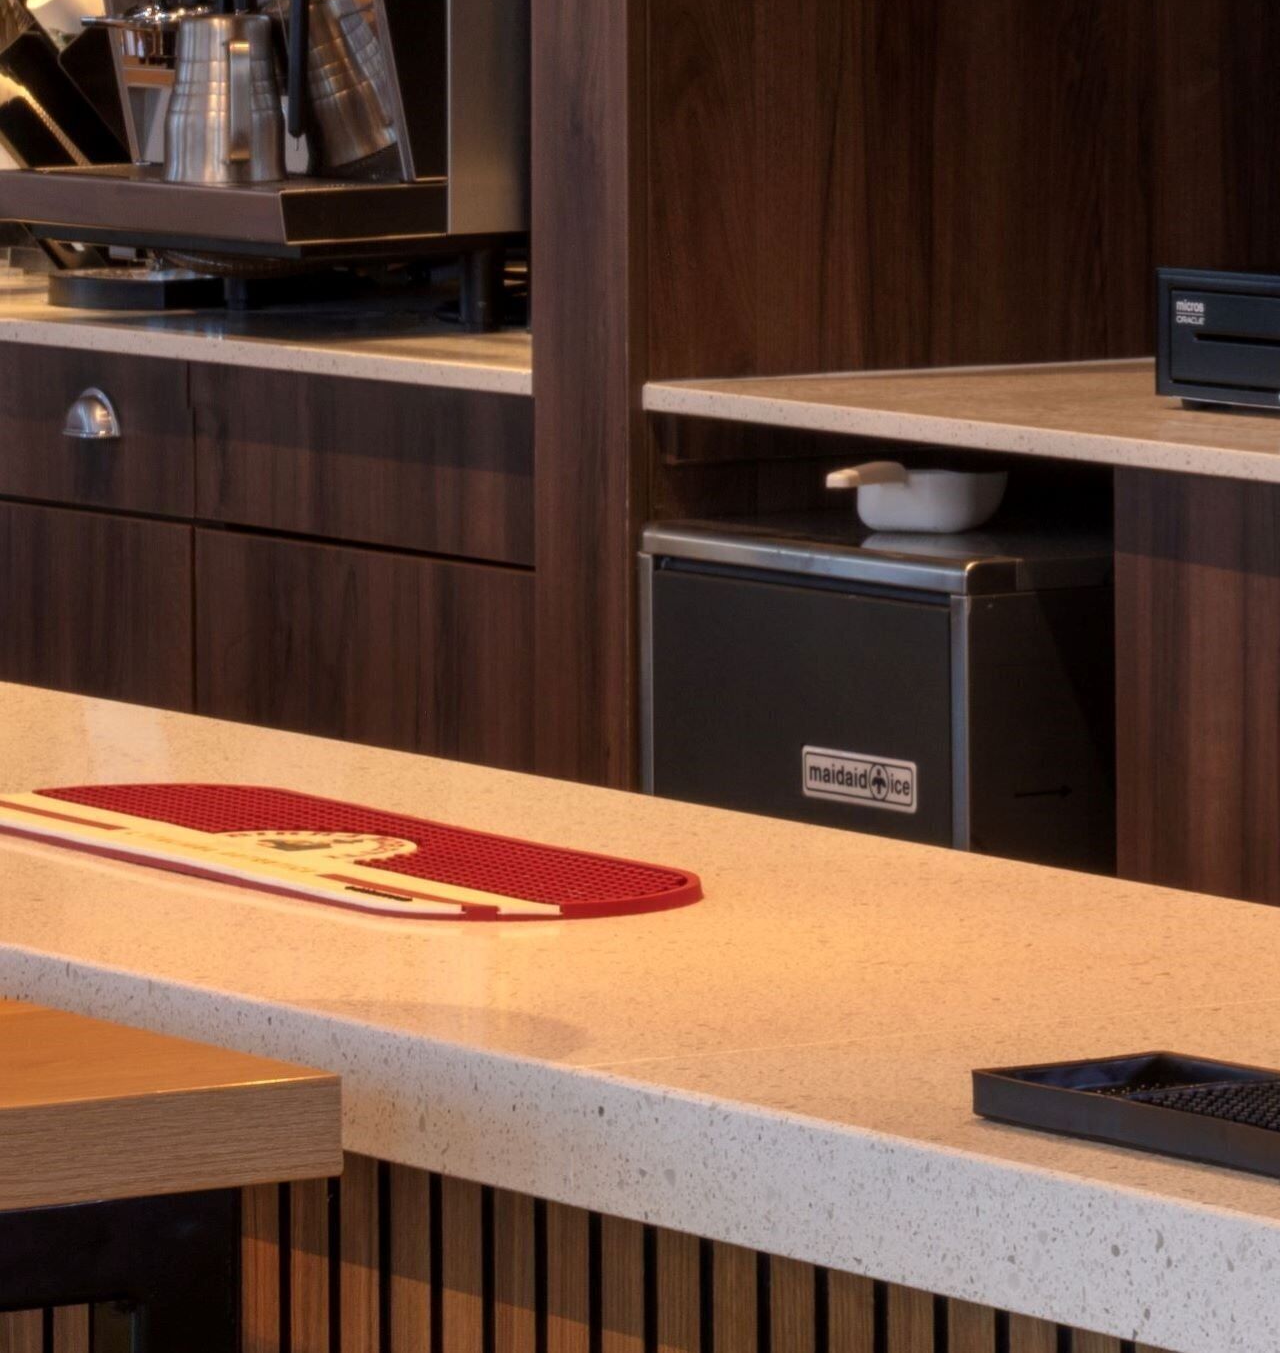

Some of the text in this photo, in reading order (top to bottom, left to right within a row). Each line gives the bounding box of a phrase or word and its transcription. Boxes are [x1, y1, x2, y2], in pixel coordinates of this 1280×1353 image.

[1176, 299, 1204, 312] micros
[809, 764, 910, 796] maidaid ice
